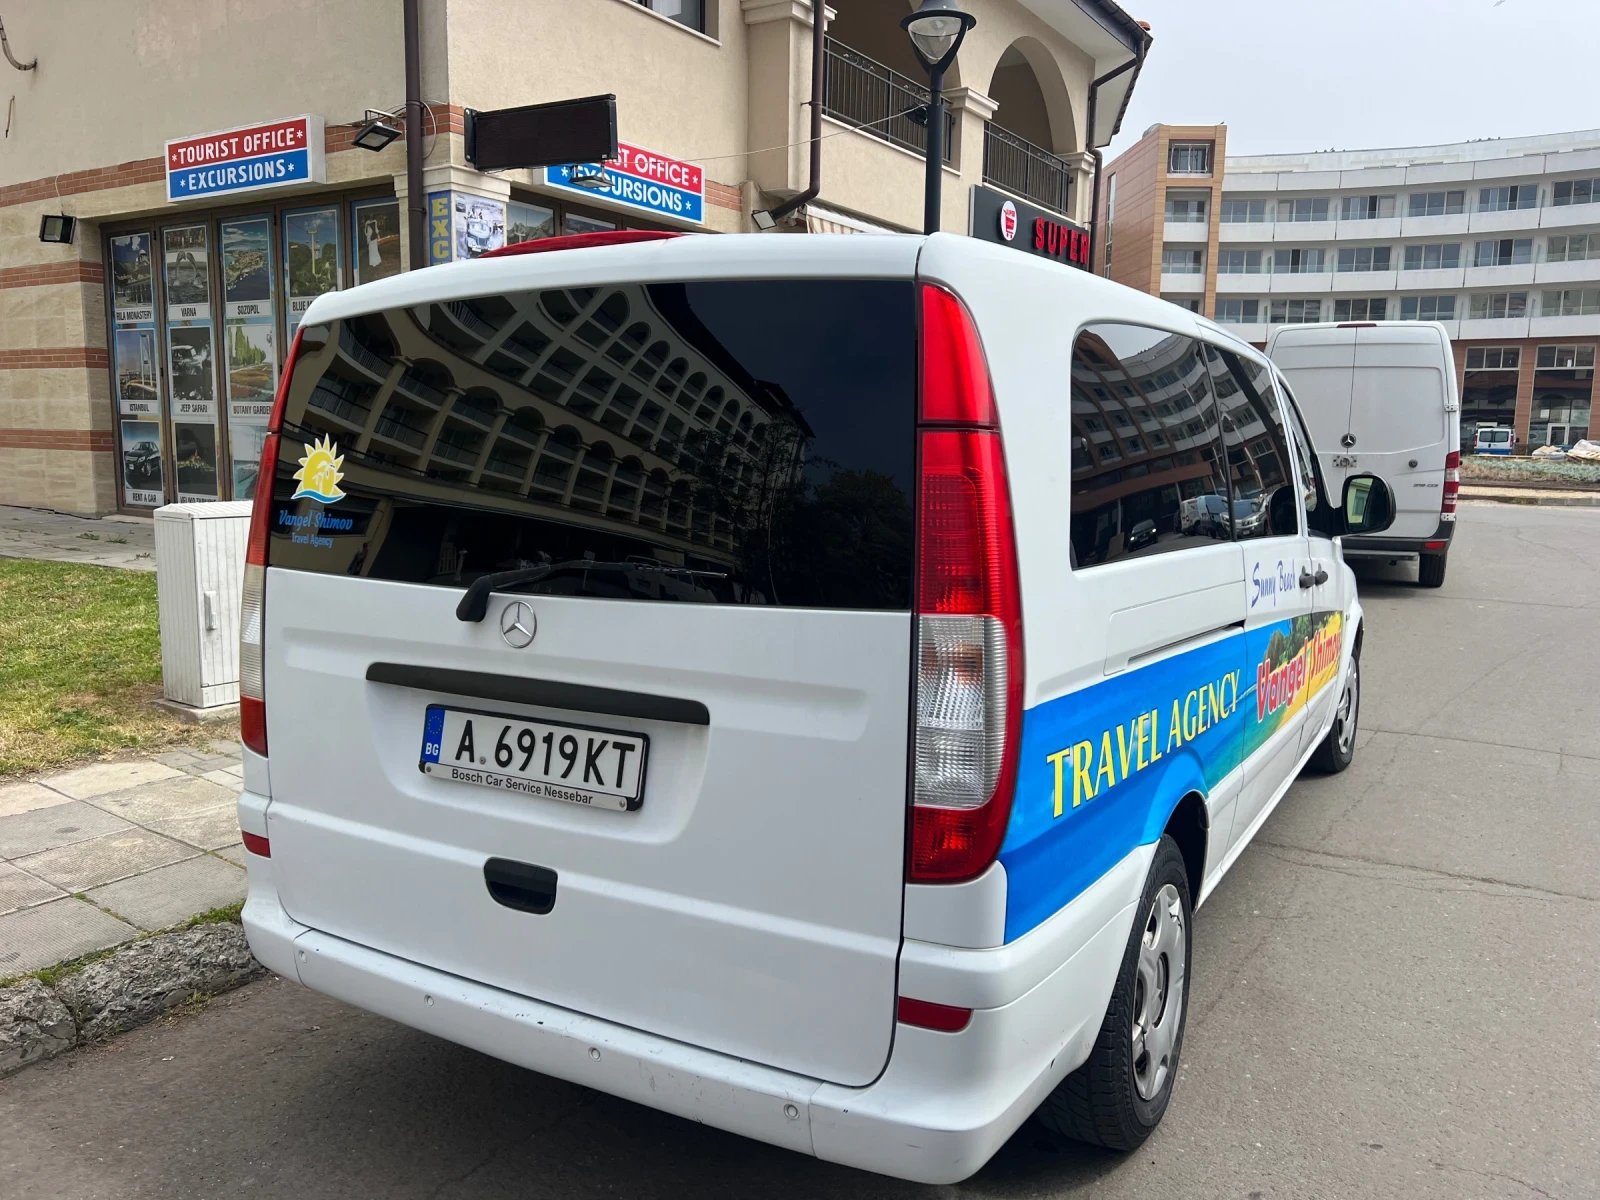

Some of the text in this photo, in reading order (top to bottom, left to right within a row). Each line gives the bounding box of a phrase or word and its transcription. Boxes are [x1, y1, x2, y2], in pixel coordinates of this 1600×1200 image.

[178, 127, 295, 164] TOURIST OFFICE
[188, 159, 285, 191] EXCURSIONS
[634, 153, 689, 186] OFFICE
[432, 197, 449, 266] EXC
[1035, 216, 1088, 264] SUPER
[116, 310, 152, 321] RILA MONASTERY
[180, 307, 197, 317] VARNA
[237, 304, 260, 315] SOZOPOL
[292, 301, 306, 311] BLUE
[129, 403, 149, 412] ISTANBUL
[180, 404, 208, 413] JEEP SAFARI
[233, 405, 251, 415] BOTANY
[132, 492, 143, 502] RENT
[147, 494, 157, 503] CAR
[279, 509, 353, 531] Vangel Shimov
[291, 532, 334, 548] Travel Agency
[1251, 559, 1296, 608] Sunny Beach
[1256, 636, 1309, 723] Vangel
[425, 742, 439, 756] BG
[1046, 669, 1240, 819] TRAVEL AGENCY
[451, 768, 593, 805] Bosch Car Service Nessebar
